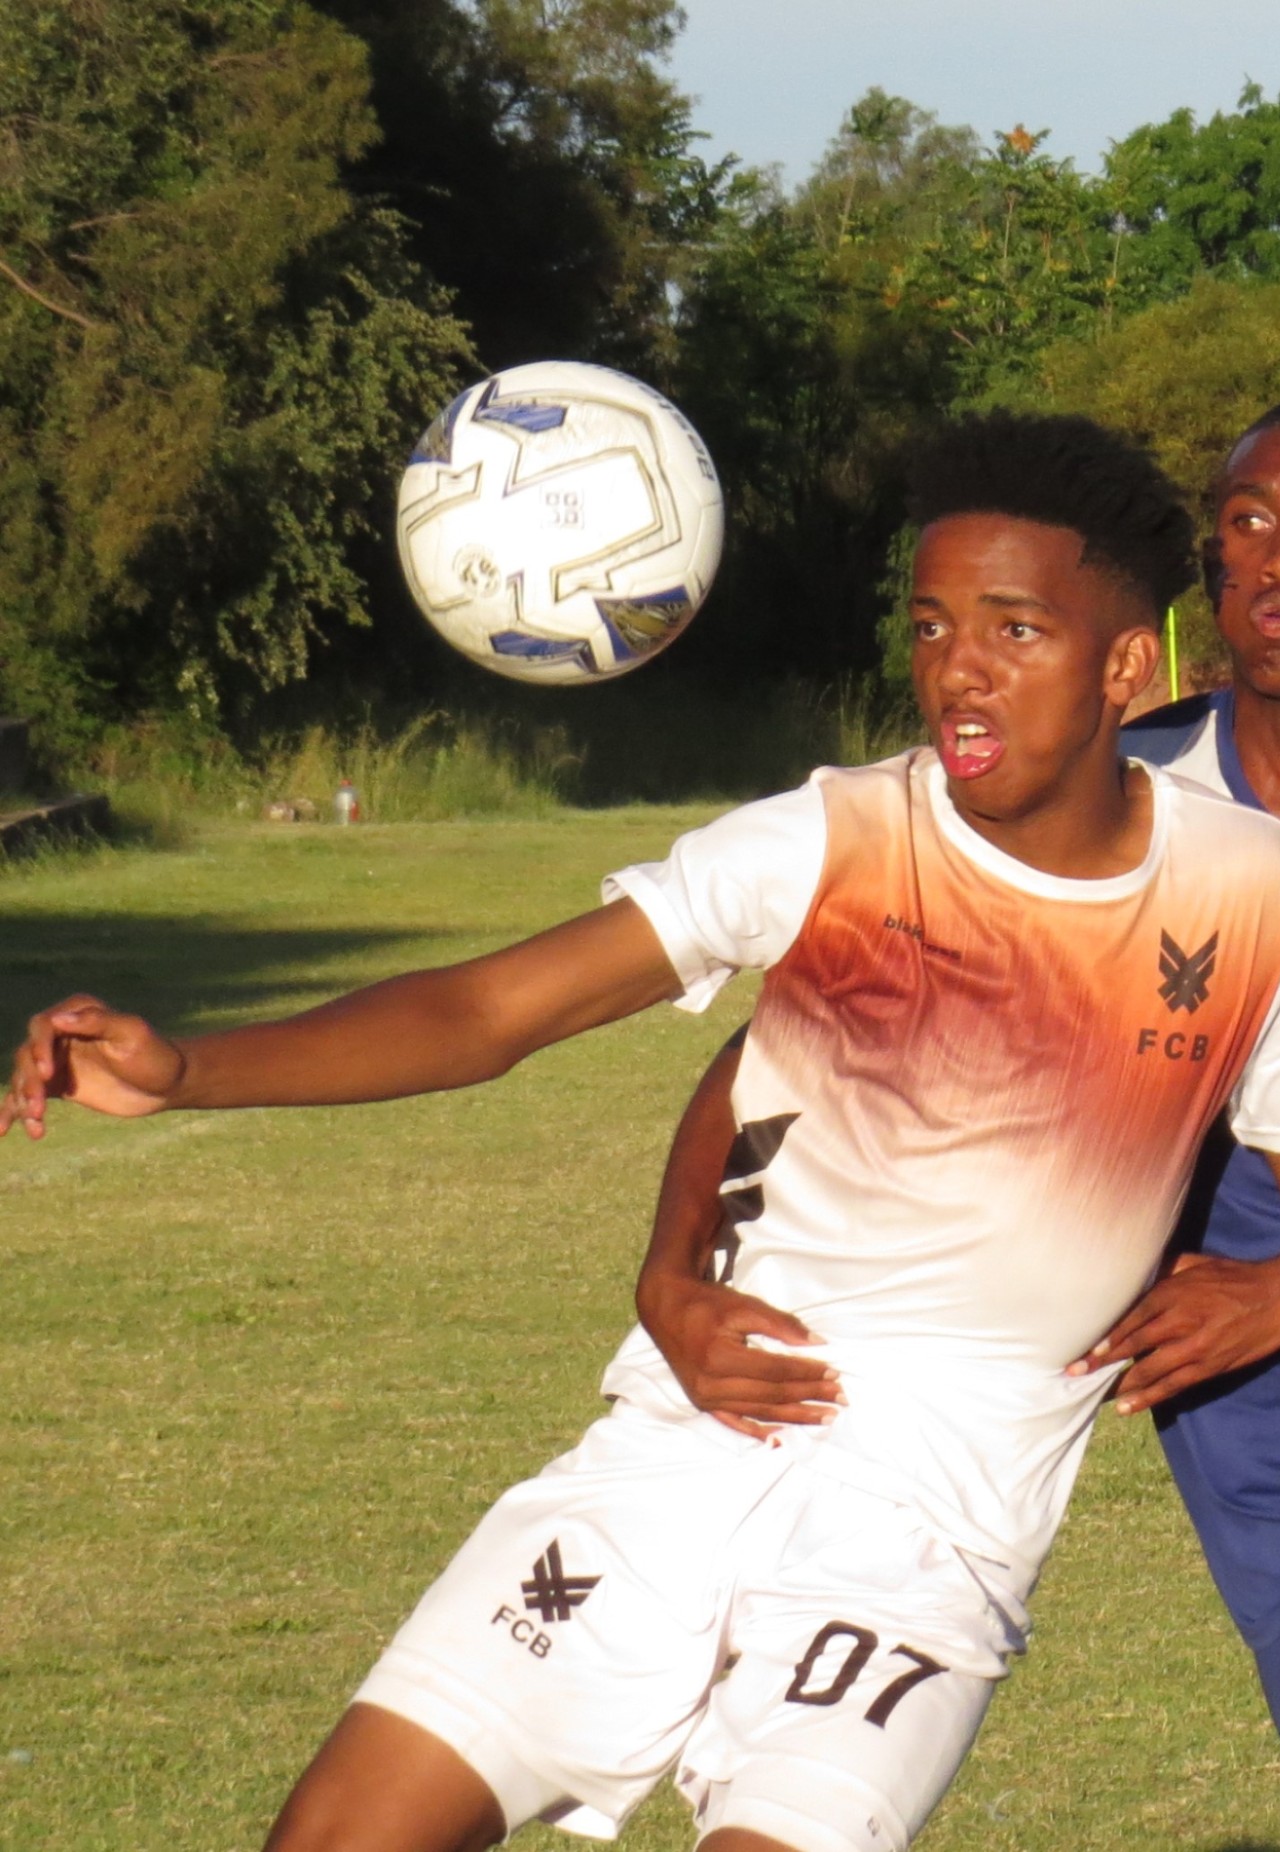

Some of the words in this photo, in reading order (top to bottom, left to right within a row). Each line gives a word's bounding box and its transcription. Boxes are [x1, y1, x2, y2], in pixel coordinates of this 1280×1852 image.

[1136, 1028, 1209, 1062] FCB
[490, 1604, 553, 1659] FCB
[784, 1619, 951, 1731] 07
